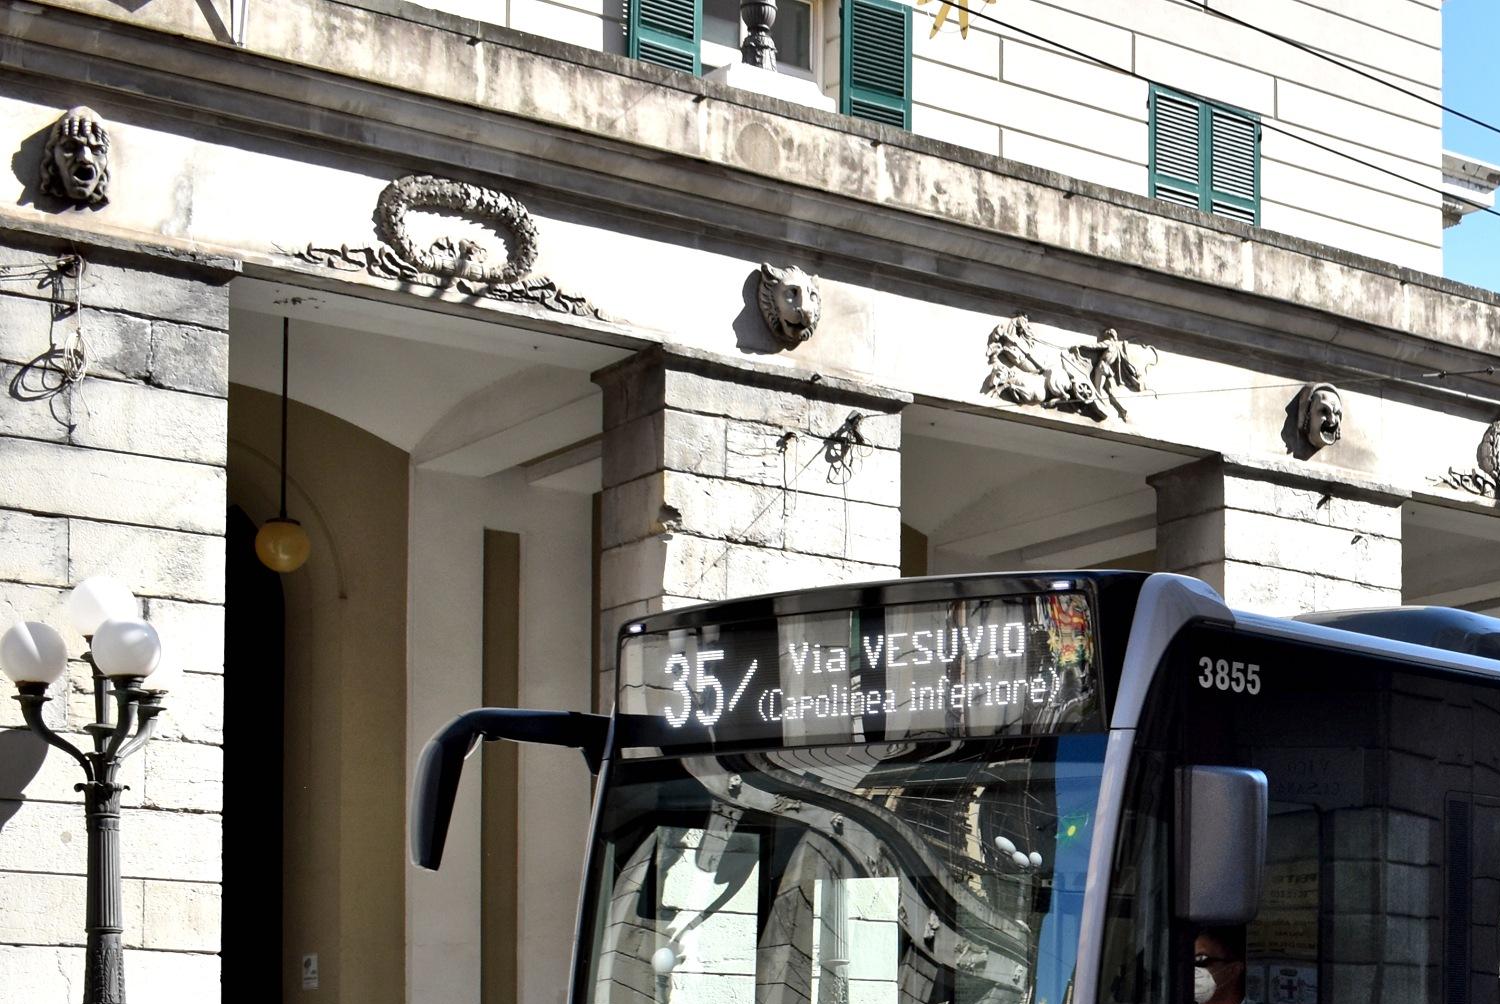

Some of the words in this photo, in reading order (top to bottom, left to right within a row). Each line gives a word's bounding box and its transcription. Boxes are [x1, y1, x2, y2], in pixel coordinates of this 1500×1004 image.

[789, 642, 846, 675] Via
[863, 622, 1025, 669] VESUVIO
[758, 684, 897, 721] (Capolinea
[909, 667, 1060, 711] inferiore)
[1199, 656, 1261, 695] 3855
